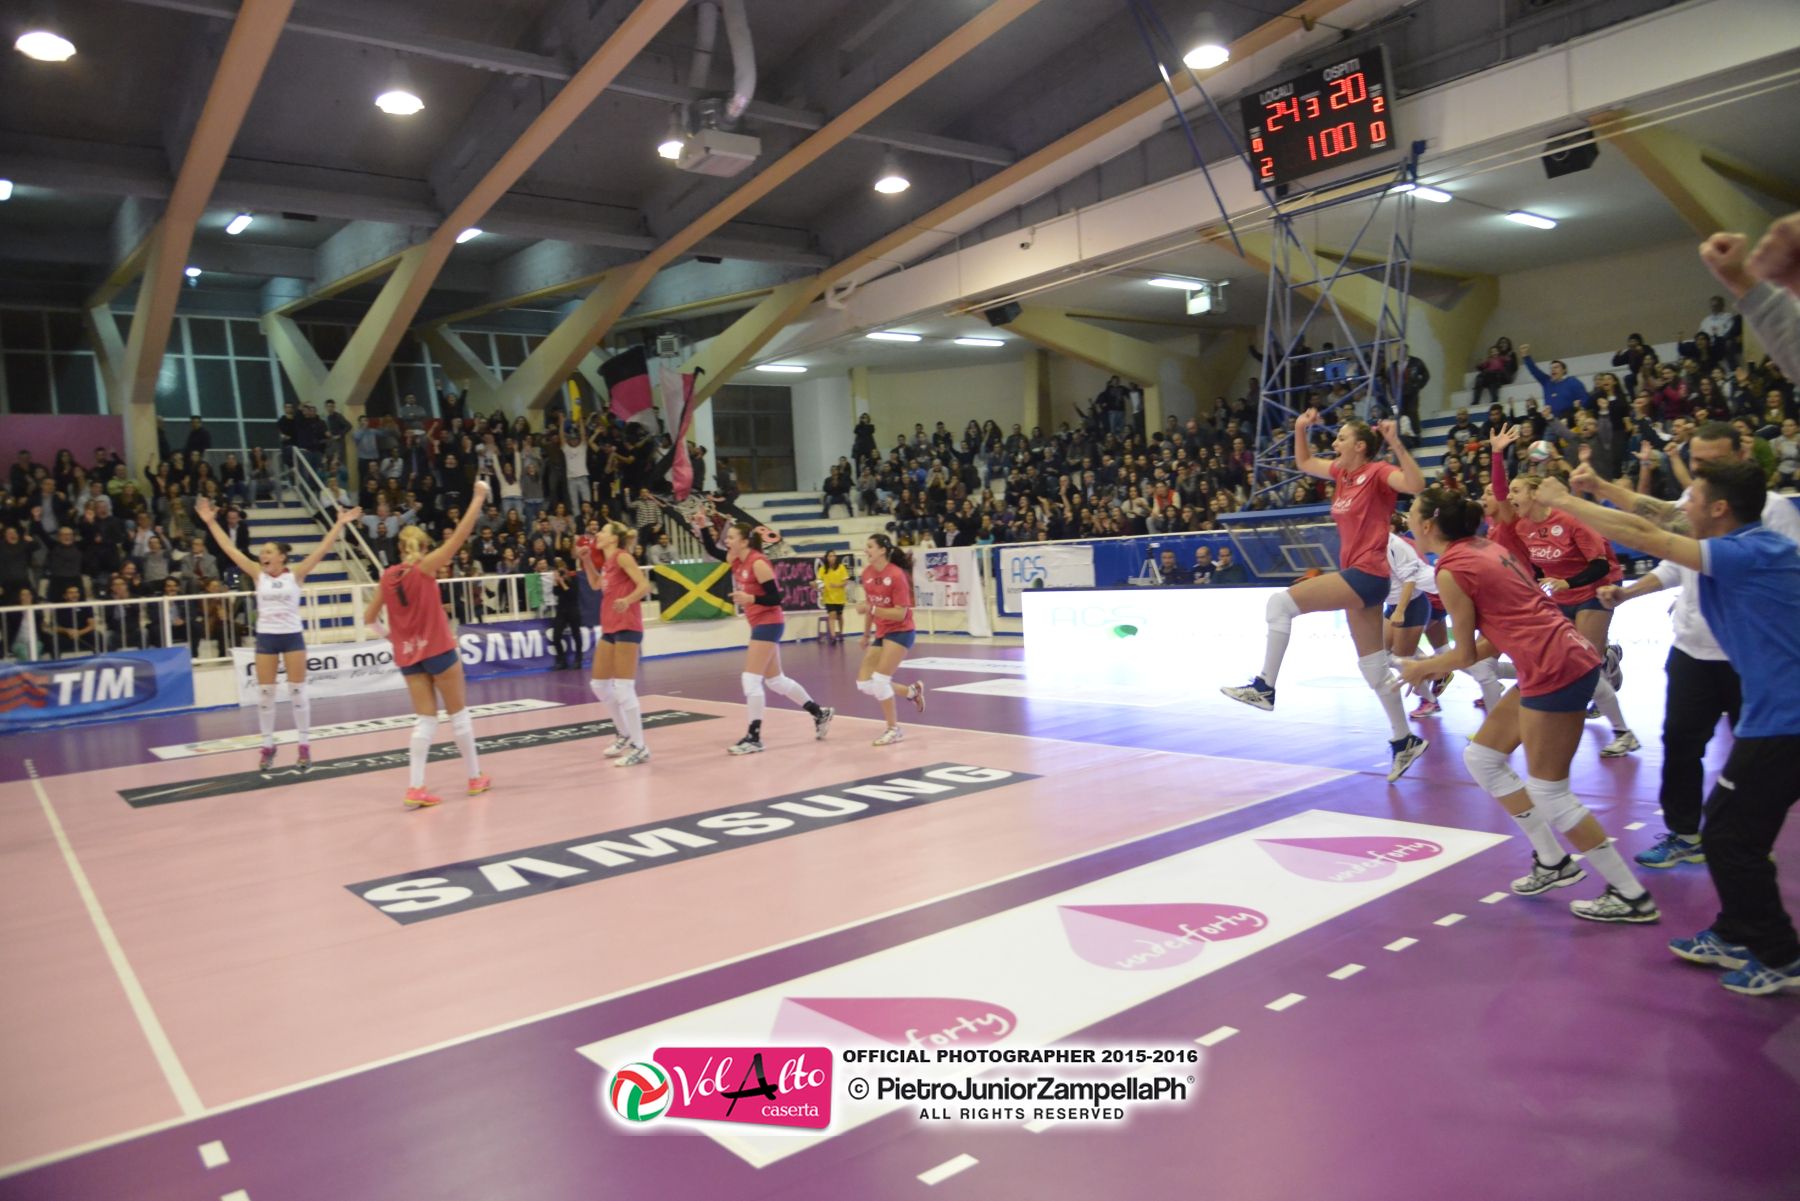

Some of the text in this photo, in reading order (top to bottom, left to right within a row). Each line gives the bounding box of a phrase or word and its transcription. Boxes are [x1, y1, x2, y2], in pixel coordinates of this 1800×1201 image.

[1306, 97, 1320, 118] 3
[1329, 72, 1367, 110] 20
[1372, 96, 1385, 113] 2
[1266, 97, 1300, 132] 24
[1370, 121, 1386, 142] 0
[1261, 157, 1274, 176] 2
[53, 666, 135, 706] TIM
[363, 765, 1013, 914] SAMSUNG
[1328, 842, 1441, 881] underforty
[1115, 911, 1264, 969] underforty
